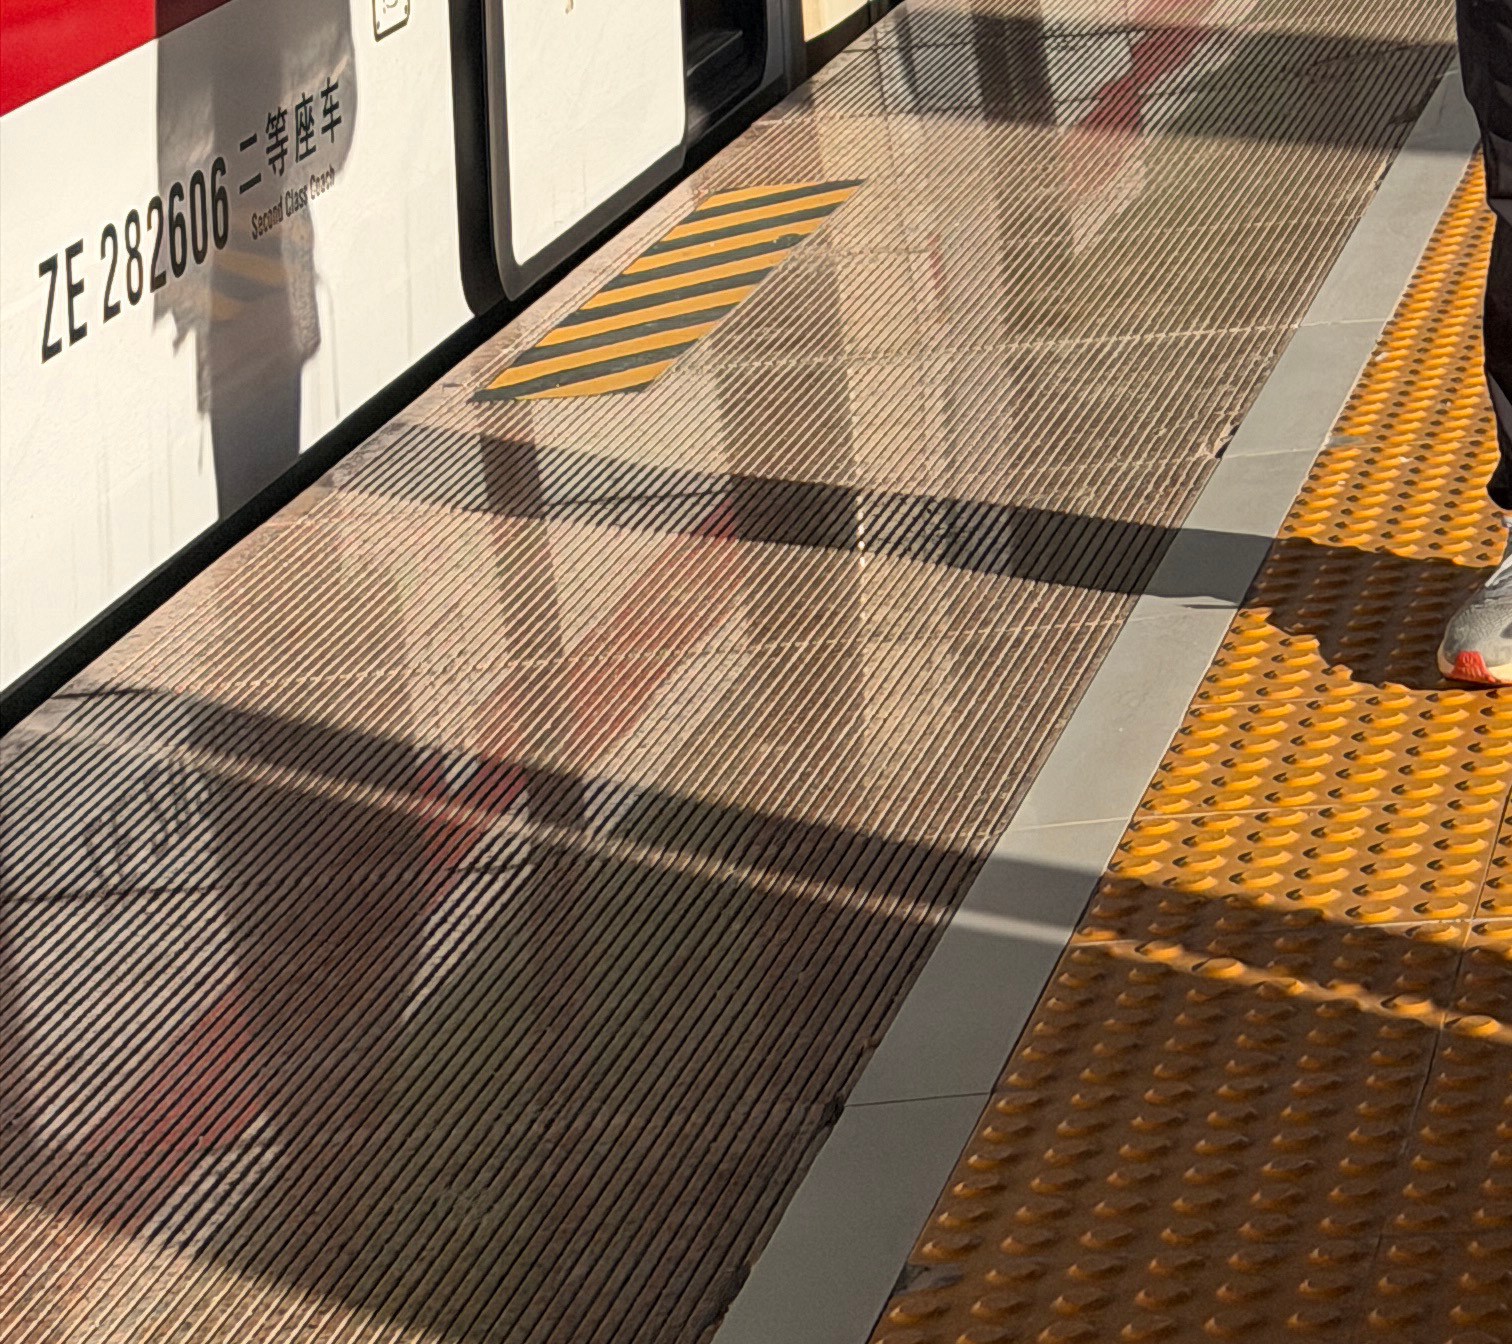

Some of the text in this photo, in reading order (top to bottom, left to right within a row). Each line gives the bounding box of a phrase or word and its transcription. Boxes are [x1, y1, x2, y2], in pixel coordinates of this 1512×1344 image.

[38, 76, 342, 364] ZE 282606 二等座车
[252, 164, 335, 240] Second Class Coach
